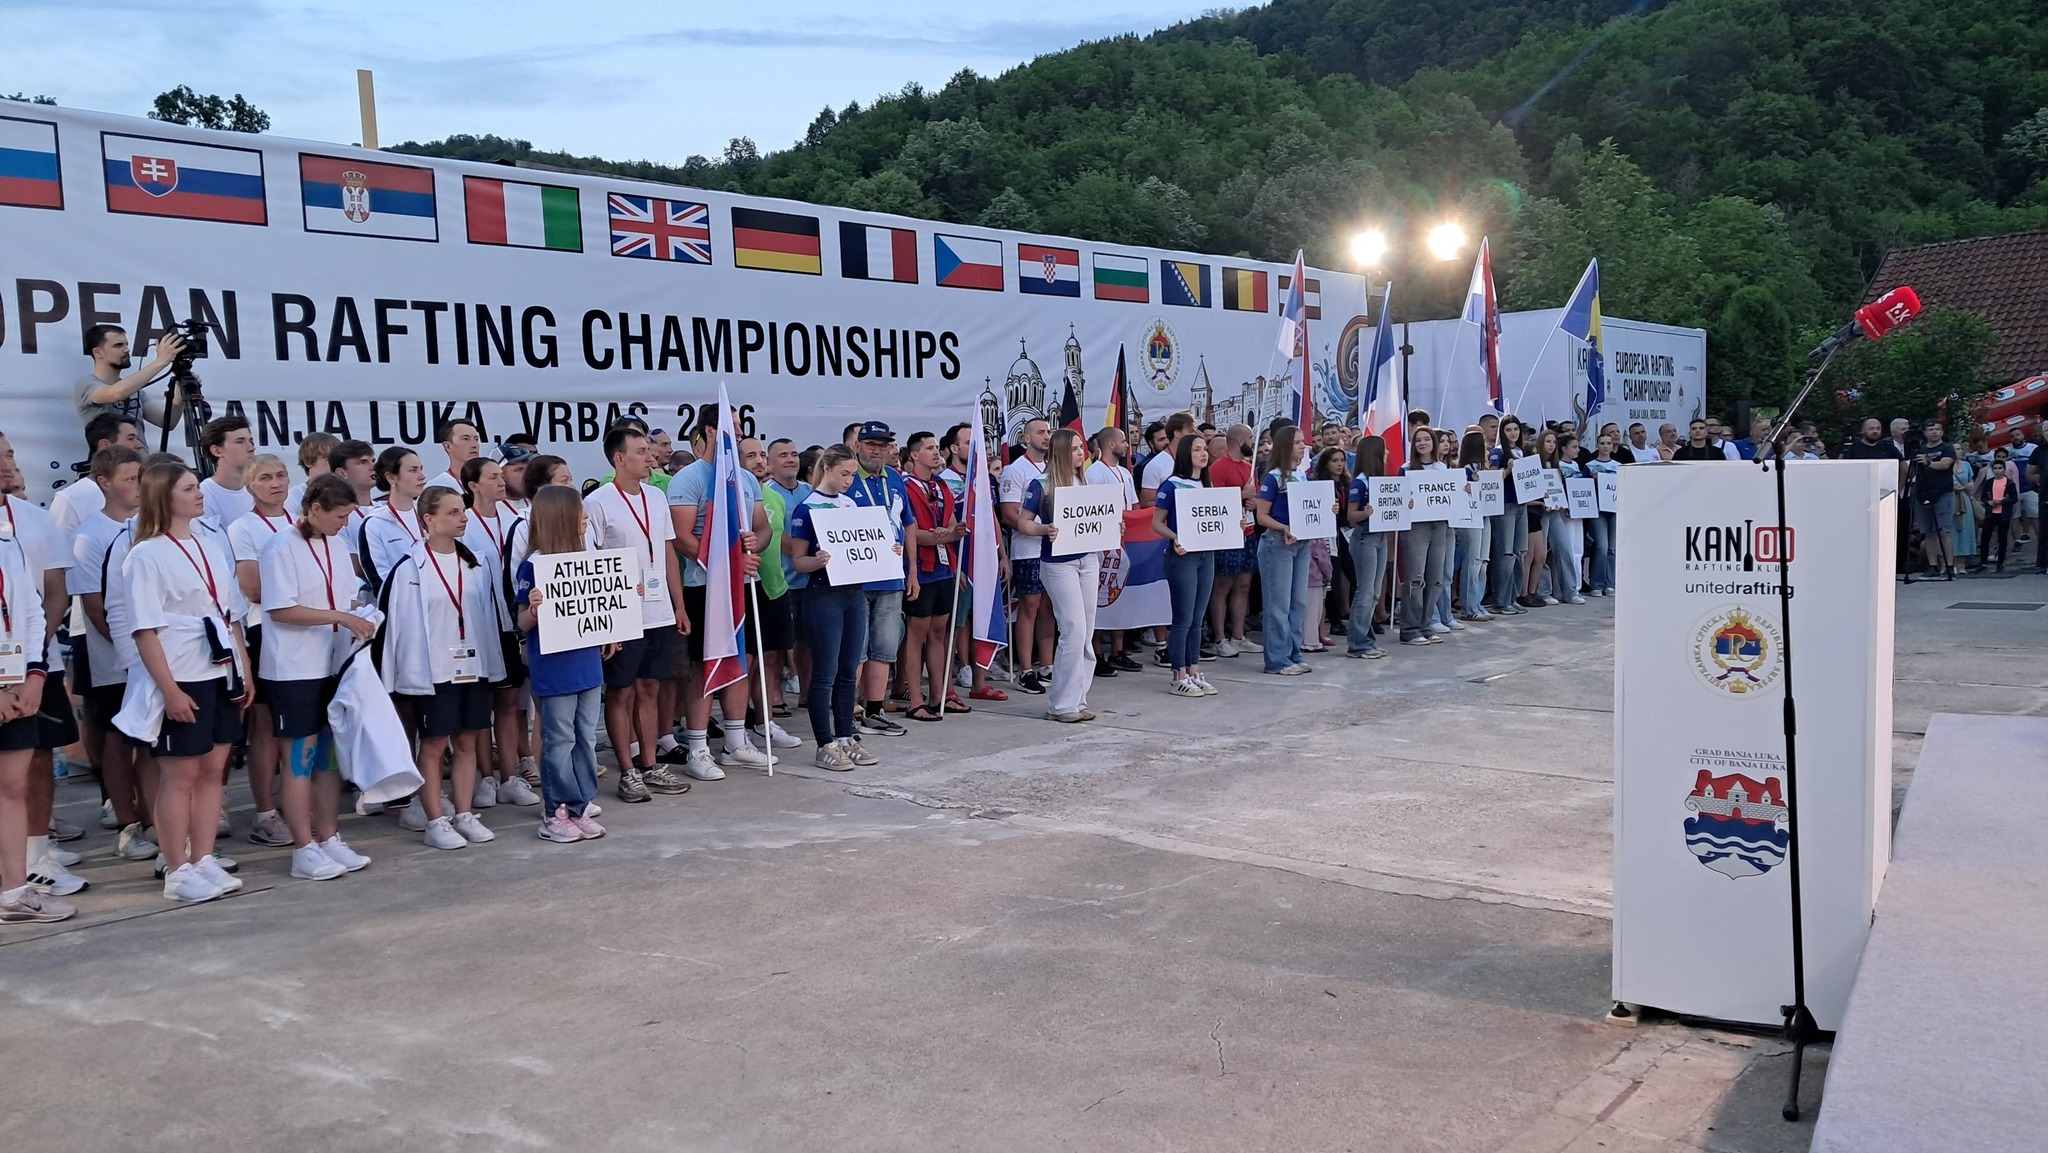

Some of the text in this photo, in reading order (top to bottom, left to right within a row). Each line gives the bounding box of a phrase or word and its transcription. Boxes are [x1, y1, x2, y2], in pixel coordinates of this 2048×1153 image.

[0, 277, 962, 381] PEAN RAFTING CHAMPIONSHIPS
[1616, 351, 1650, 376] EUROPEAN
[1650, 354, 1674, 378] RAFTING
[1624, 378, 1672, 402] CHAMPIONSHIP
[369, 400, 502, 447] LUKA,
[677, 403, 767, 441] 26.
[1516, 468, 1541, 480] BULGARIA
[1380, 484, 1401, 494] GREAT
[1418, 482, 1456, 493] FRANCE
[1480, 482, 1500, 491] CROATIA
[1524, 480, 1537, 491] (BUL)
[1426, 495, 1452, 507] (FRA)
[1484, 494, 1497, 503] (CRO)
[1572, 490, 1592, 499] BELGIUM
[1302, 499, 1322, 510] ITALY
[1378, 497, 1403, 507] BRITAIN
[1578, 500, 1590, 508] (BEL)
[1062, 503, 1115, 520] SLOVAKIA
[1191, 505, 1228, 518] SERBIA
[1381, 510, 1400, 522] (GBR)
[1305, 513, 1321, 526] (ITA)
[1074, 521, 1102, 538] (SVK)
[1197, 520, 1225, 534] (SER)
[826, 528, 886, 544] SLOVENIA
[846, 547, 878, 564] (SLO)
[554, 557, 622, 580] ATHLETE
[1686, 563, 1789, 572] RAFTING KLU
[545, 575, 632, 600] INDIVIDUAL
[555, 594, 627, 618] NEUTRAL
[578, 614, 613, 638] (AIN)
[1695, 748, 1780, 760] GRAD BANJA LUKA
[1690, 757, 1711, 765] CITY
[1729, 760, 1758, 769] BANJA
[1760, 763, 1786, 771] LUKA
